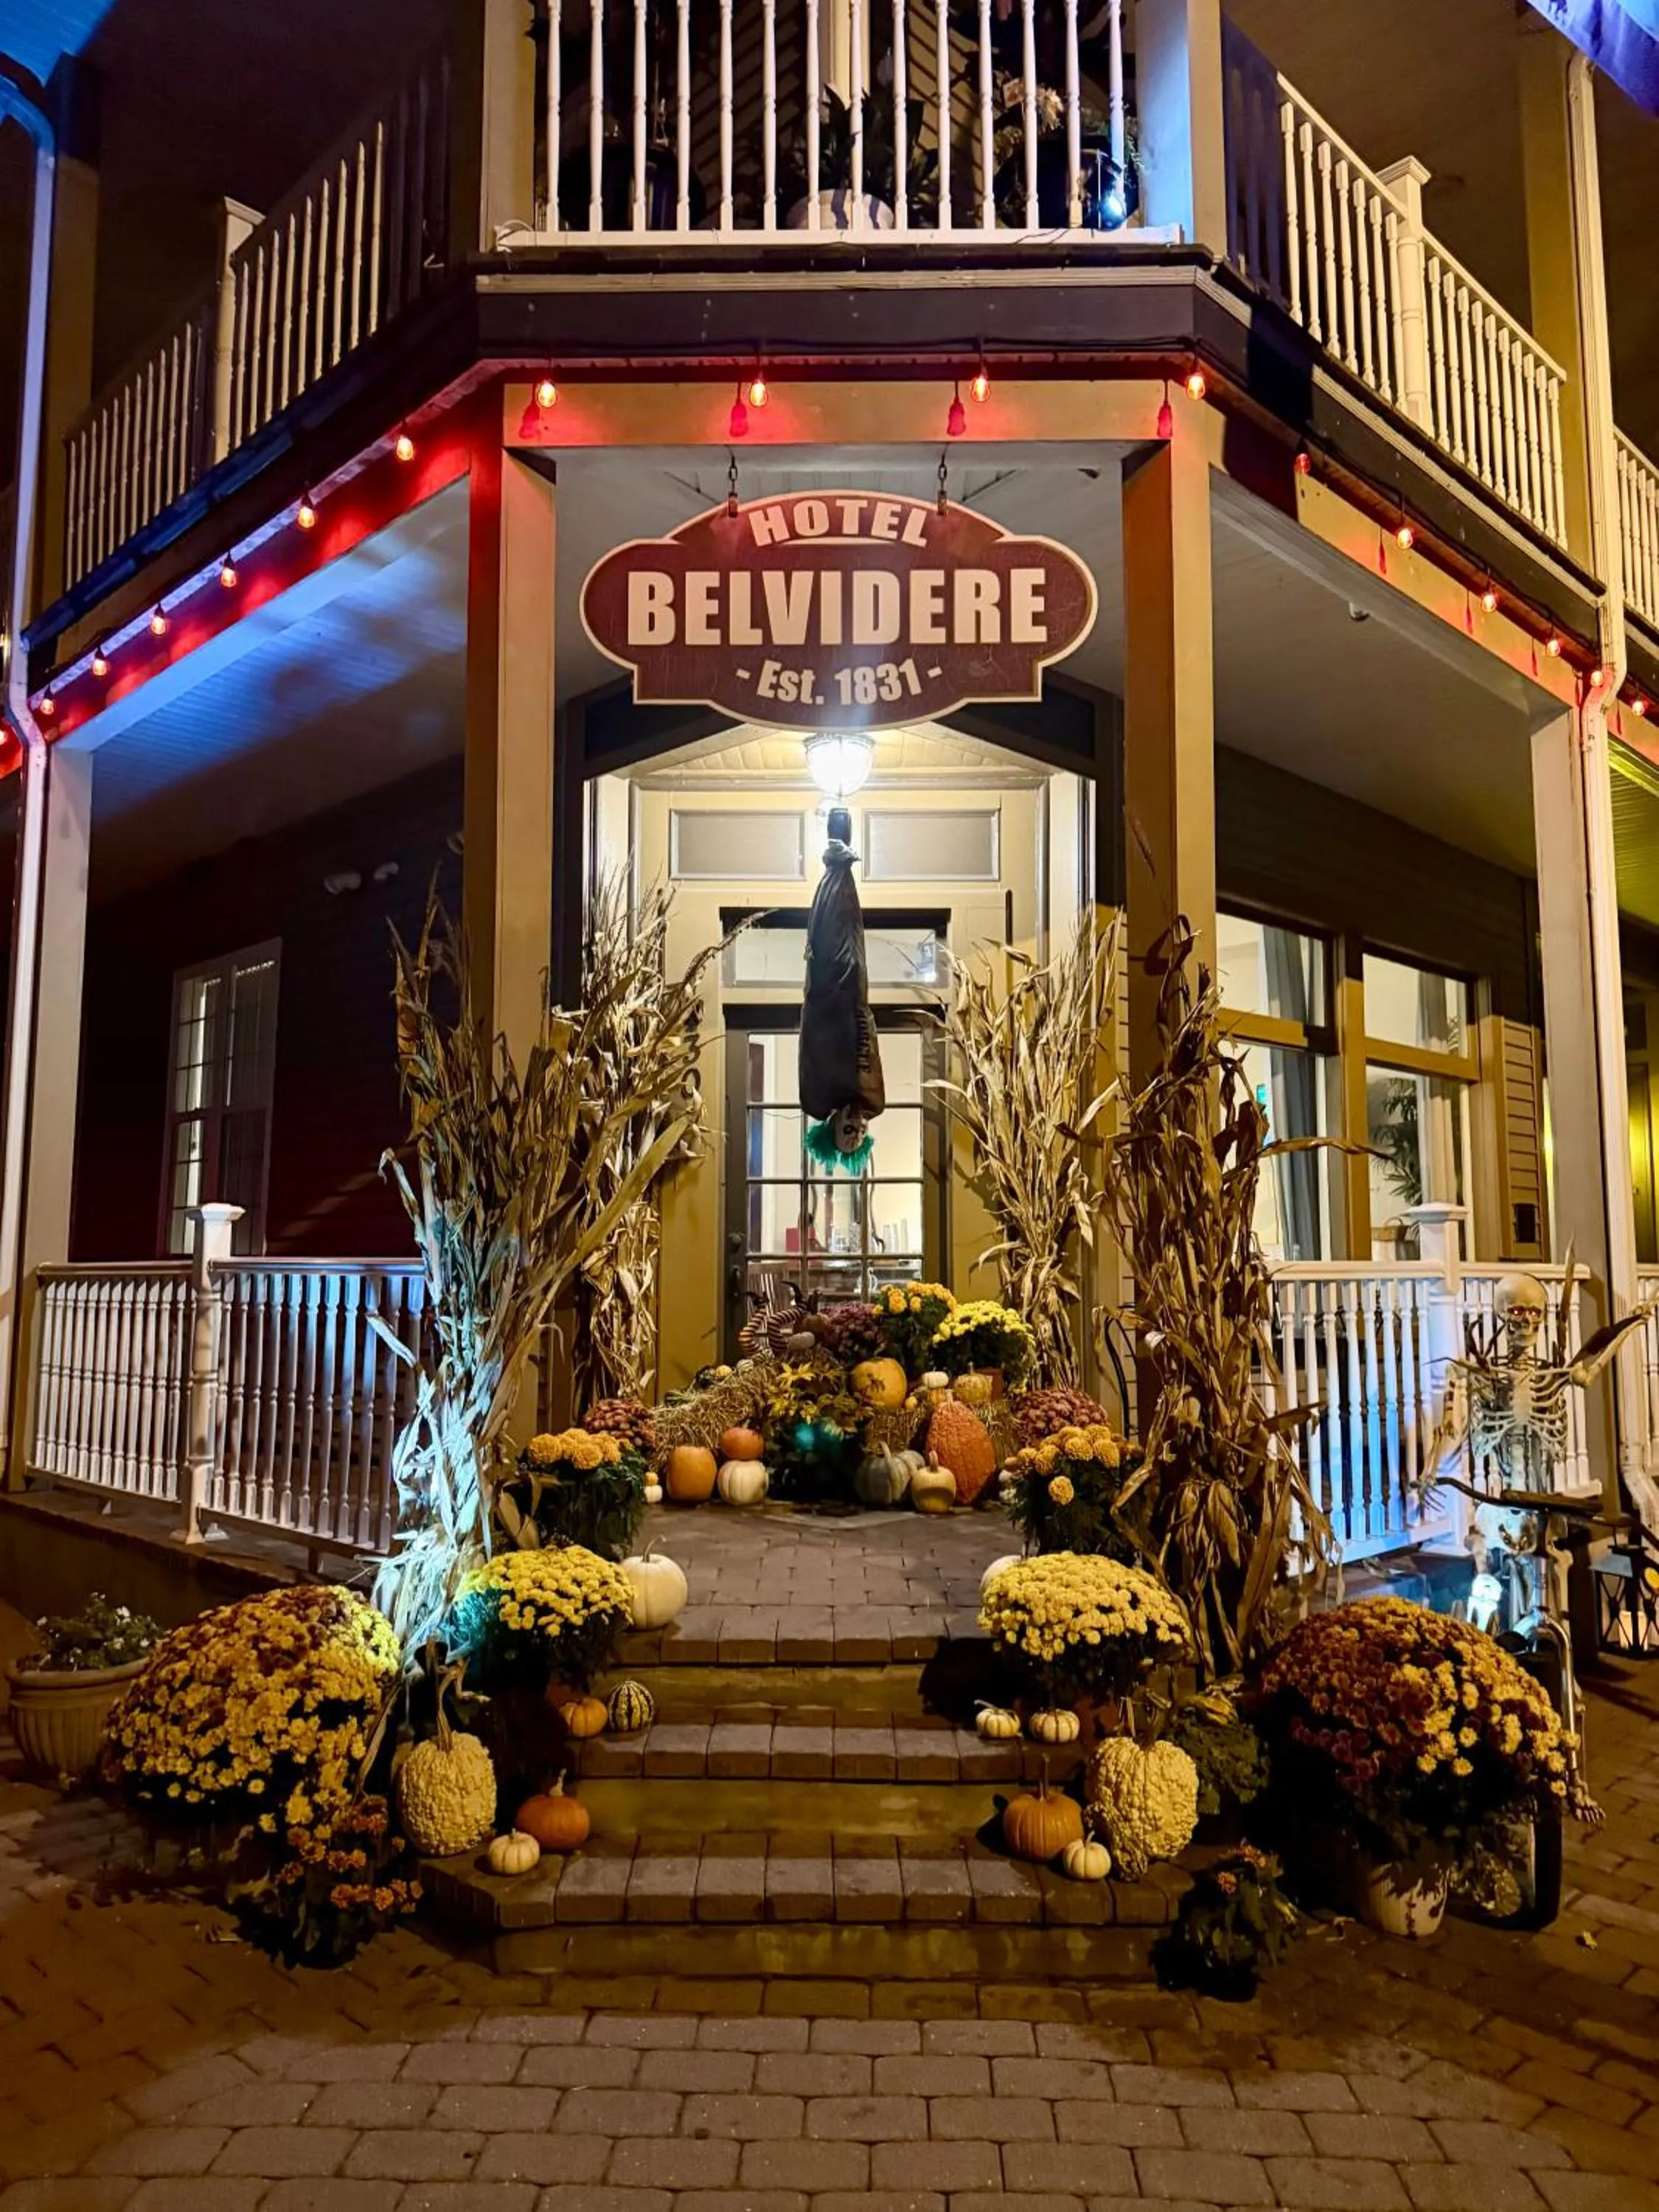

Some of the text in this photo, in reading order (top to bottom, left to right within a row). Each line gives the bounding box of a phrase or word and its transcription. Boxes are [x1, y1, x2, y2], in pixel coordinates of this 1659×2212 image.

[749, 498, 927, 547] HOTEL
[627, 568, 1048, 646] BELVIDERE
[757, 660, 824, 705] Est.
[835, 658, 922, 706] 1831
